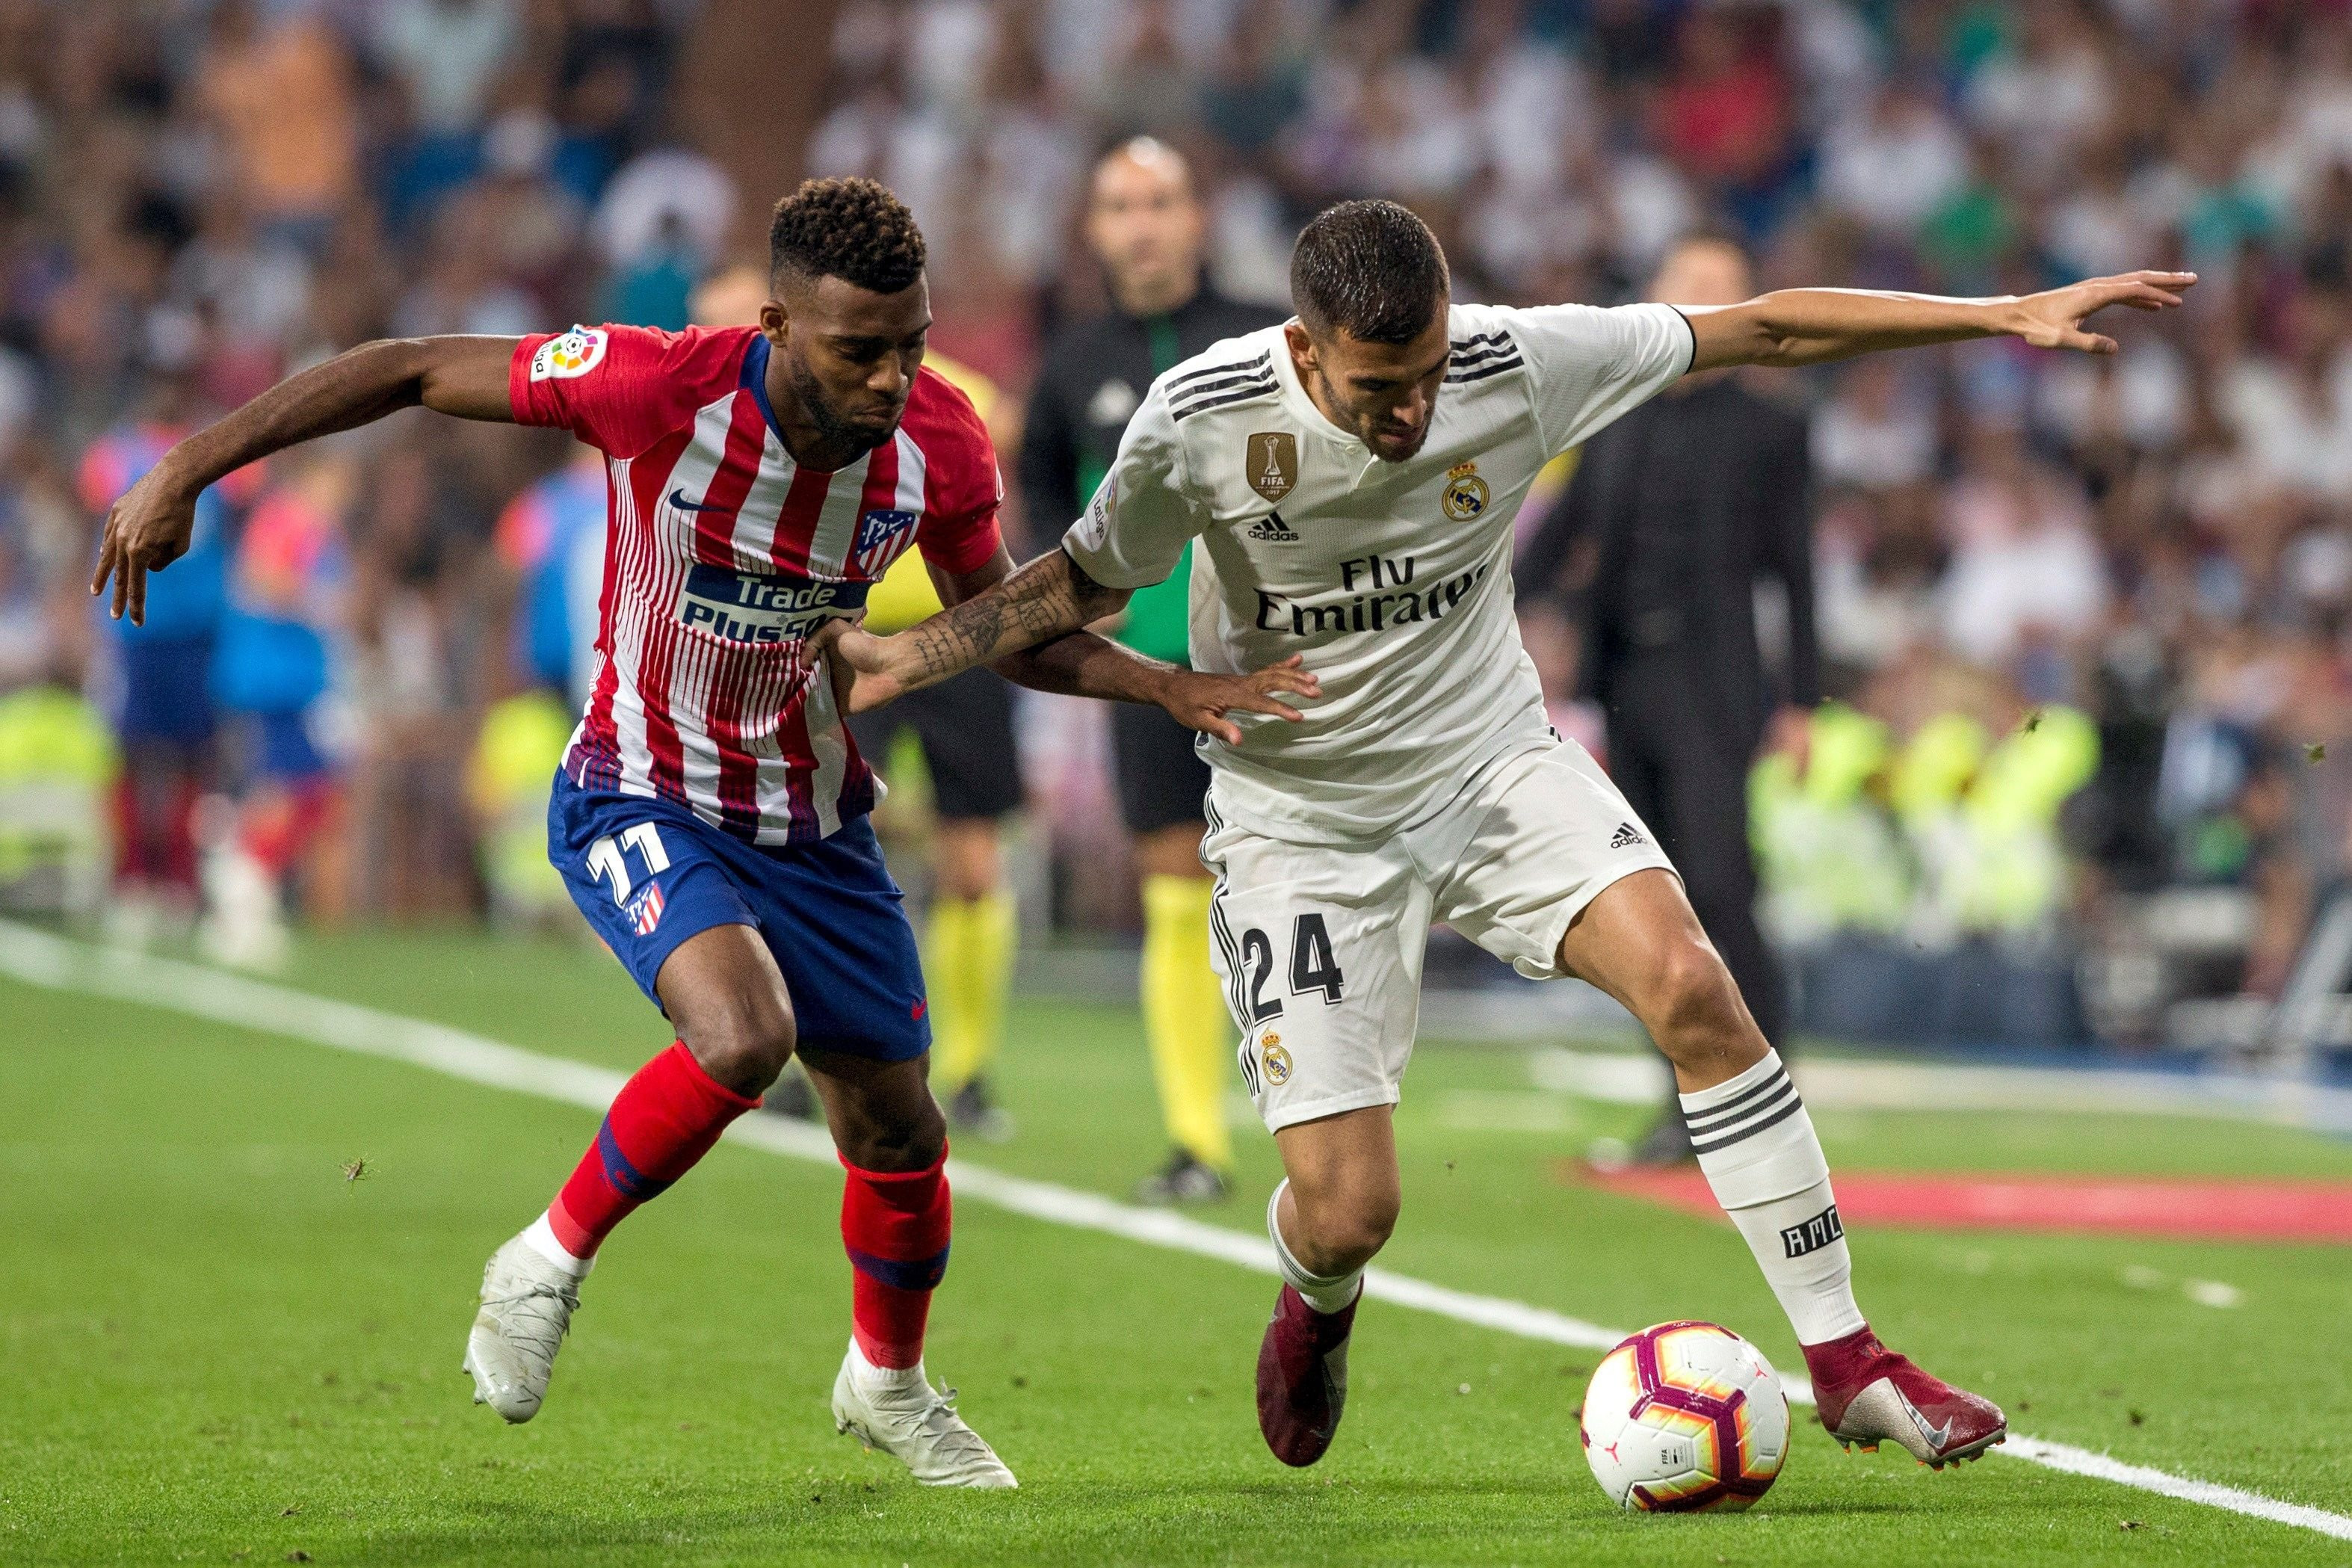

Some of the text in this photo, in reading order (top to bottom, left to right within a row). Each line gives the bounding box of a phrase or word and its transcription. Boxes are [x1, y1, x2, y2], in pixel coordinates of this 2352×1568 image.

[1261, 476, 1285, 486] FIFA
[1093, 498, 1105, 540] LaLiga
[1247, 529, 1299, 541] adidas
[736, 575, 837, 609] Trade
[1611, 835, 1653, 849] adida
[585, 821, 663, 910] 11
[1241, 913, 1344, 1028] 24
